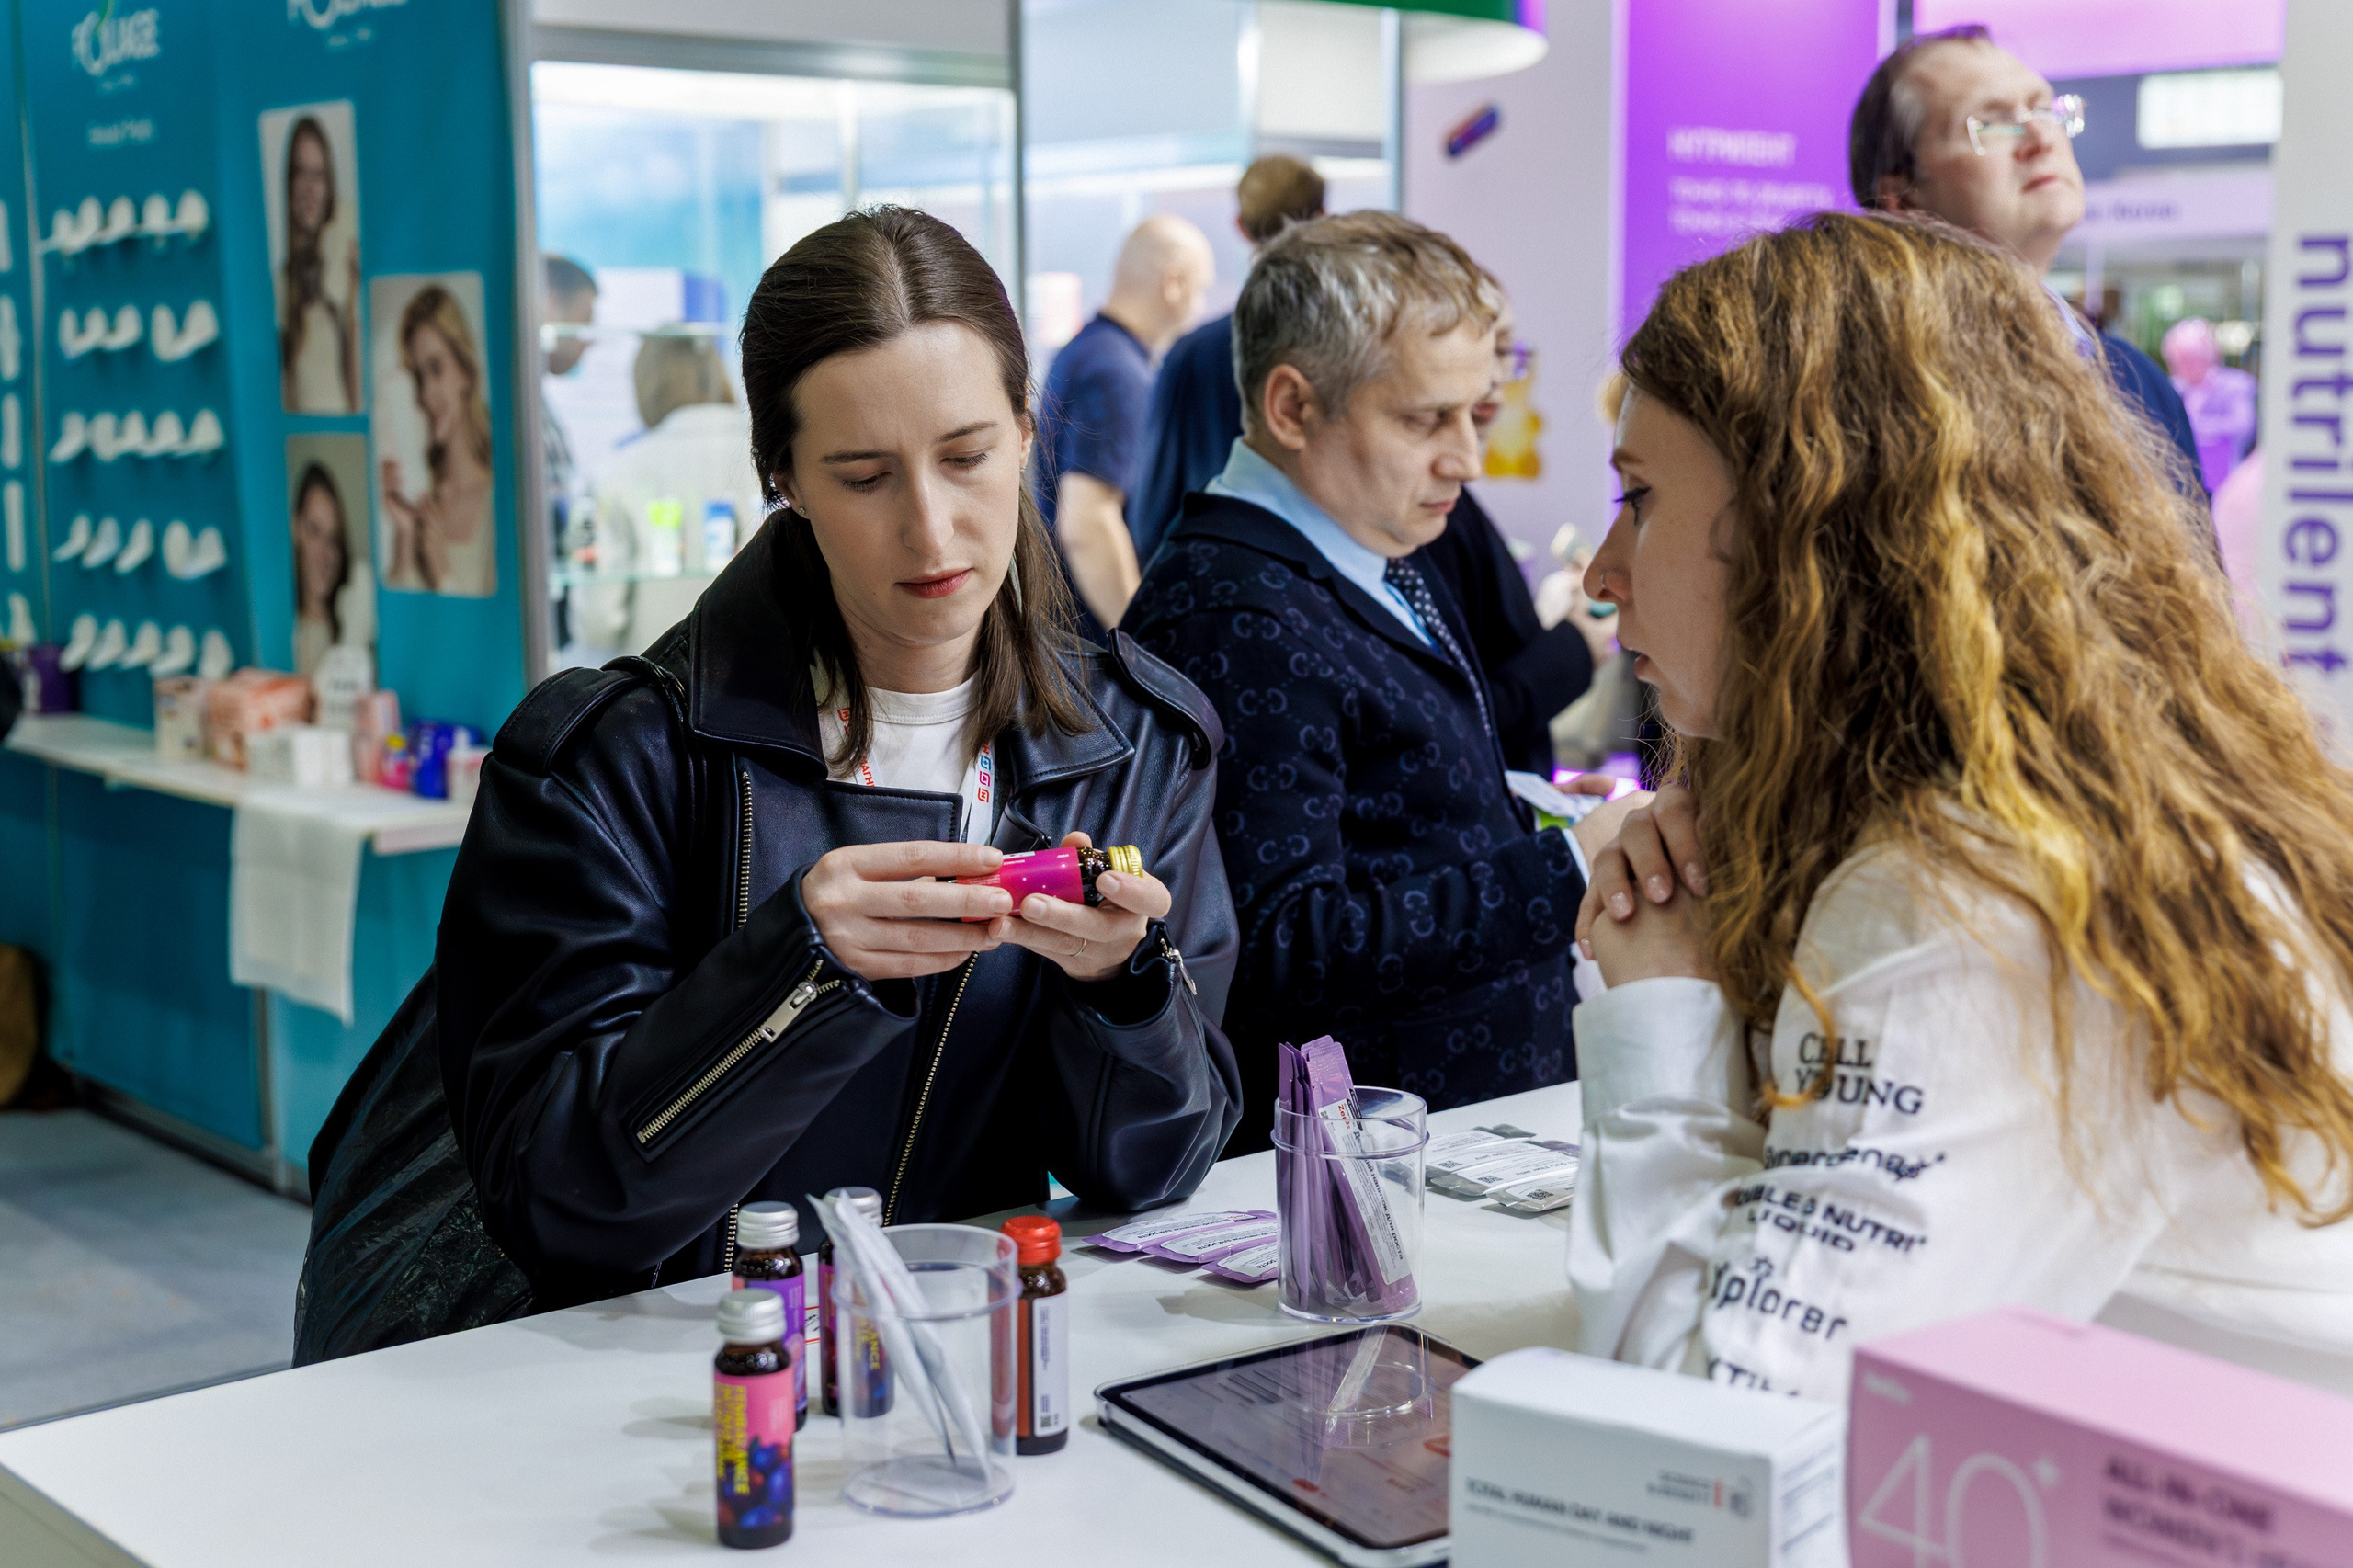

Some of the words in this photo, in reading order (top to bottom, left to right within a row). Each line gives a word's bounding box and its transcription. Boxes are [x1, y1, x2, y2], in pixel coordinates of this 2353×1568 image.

[1353, 1131, 1374, 1171] Деий
[1385, 1212, 1395, 1233] для
[1392, 1232, 1404, 1261] роста
